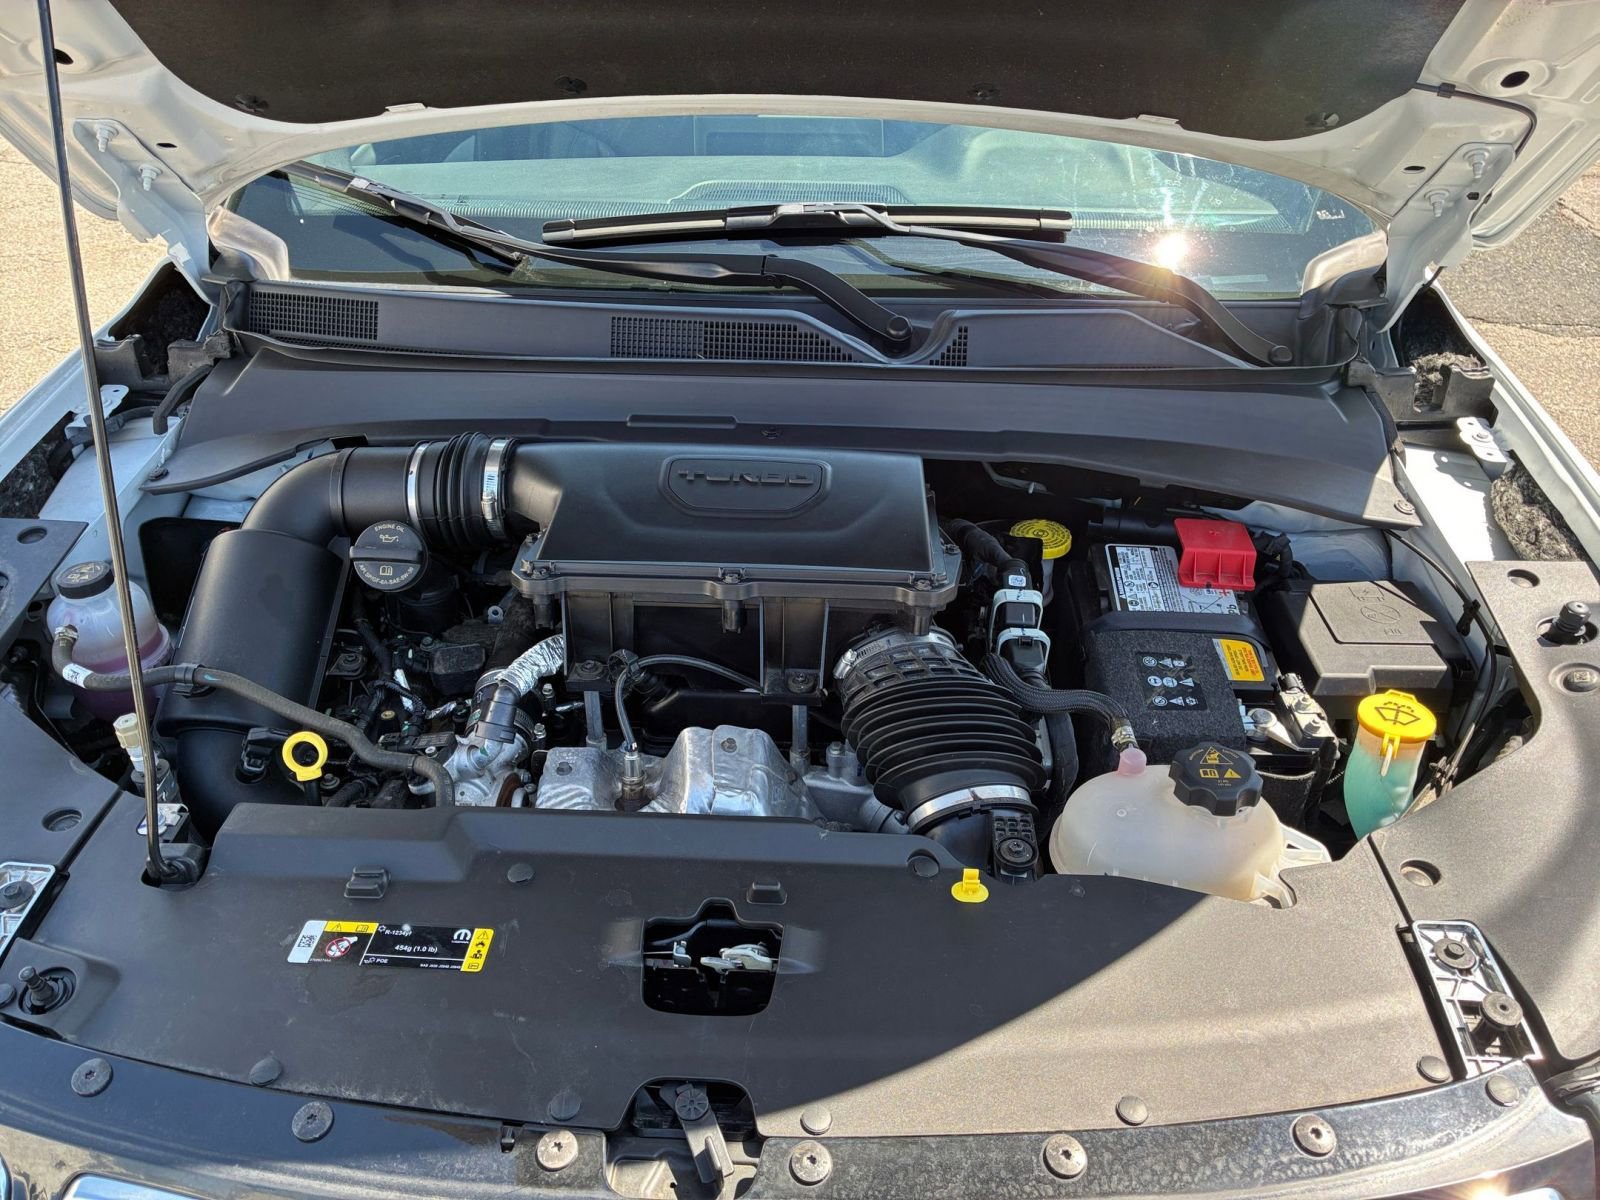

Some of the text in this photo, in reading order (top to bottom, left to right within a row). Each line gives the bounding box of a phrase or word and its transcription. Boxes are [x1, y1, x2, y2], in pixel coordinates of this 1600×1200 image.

[374, 523, 405, 533] ENGINE OIL
[385, 929, 413, 937] R-1234yf
[394, 944, 438, 954] 454g (1.0 lb)
